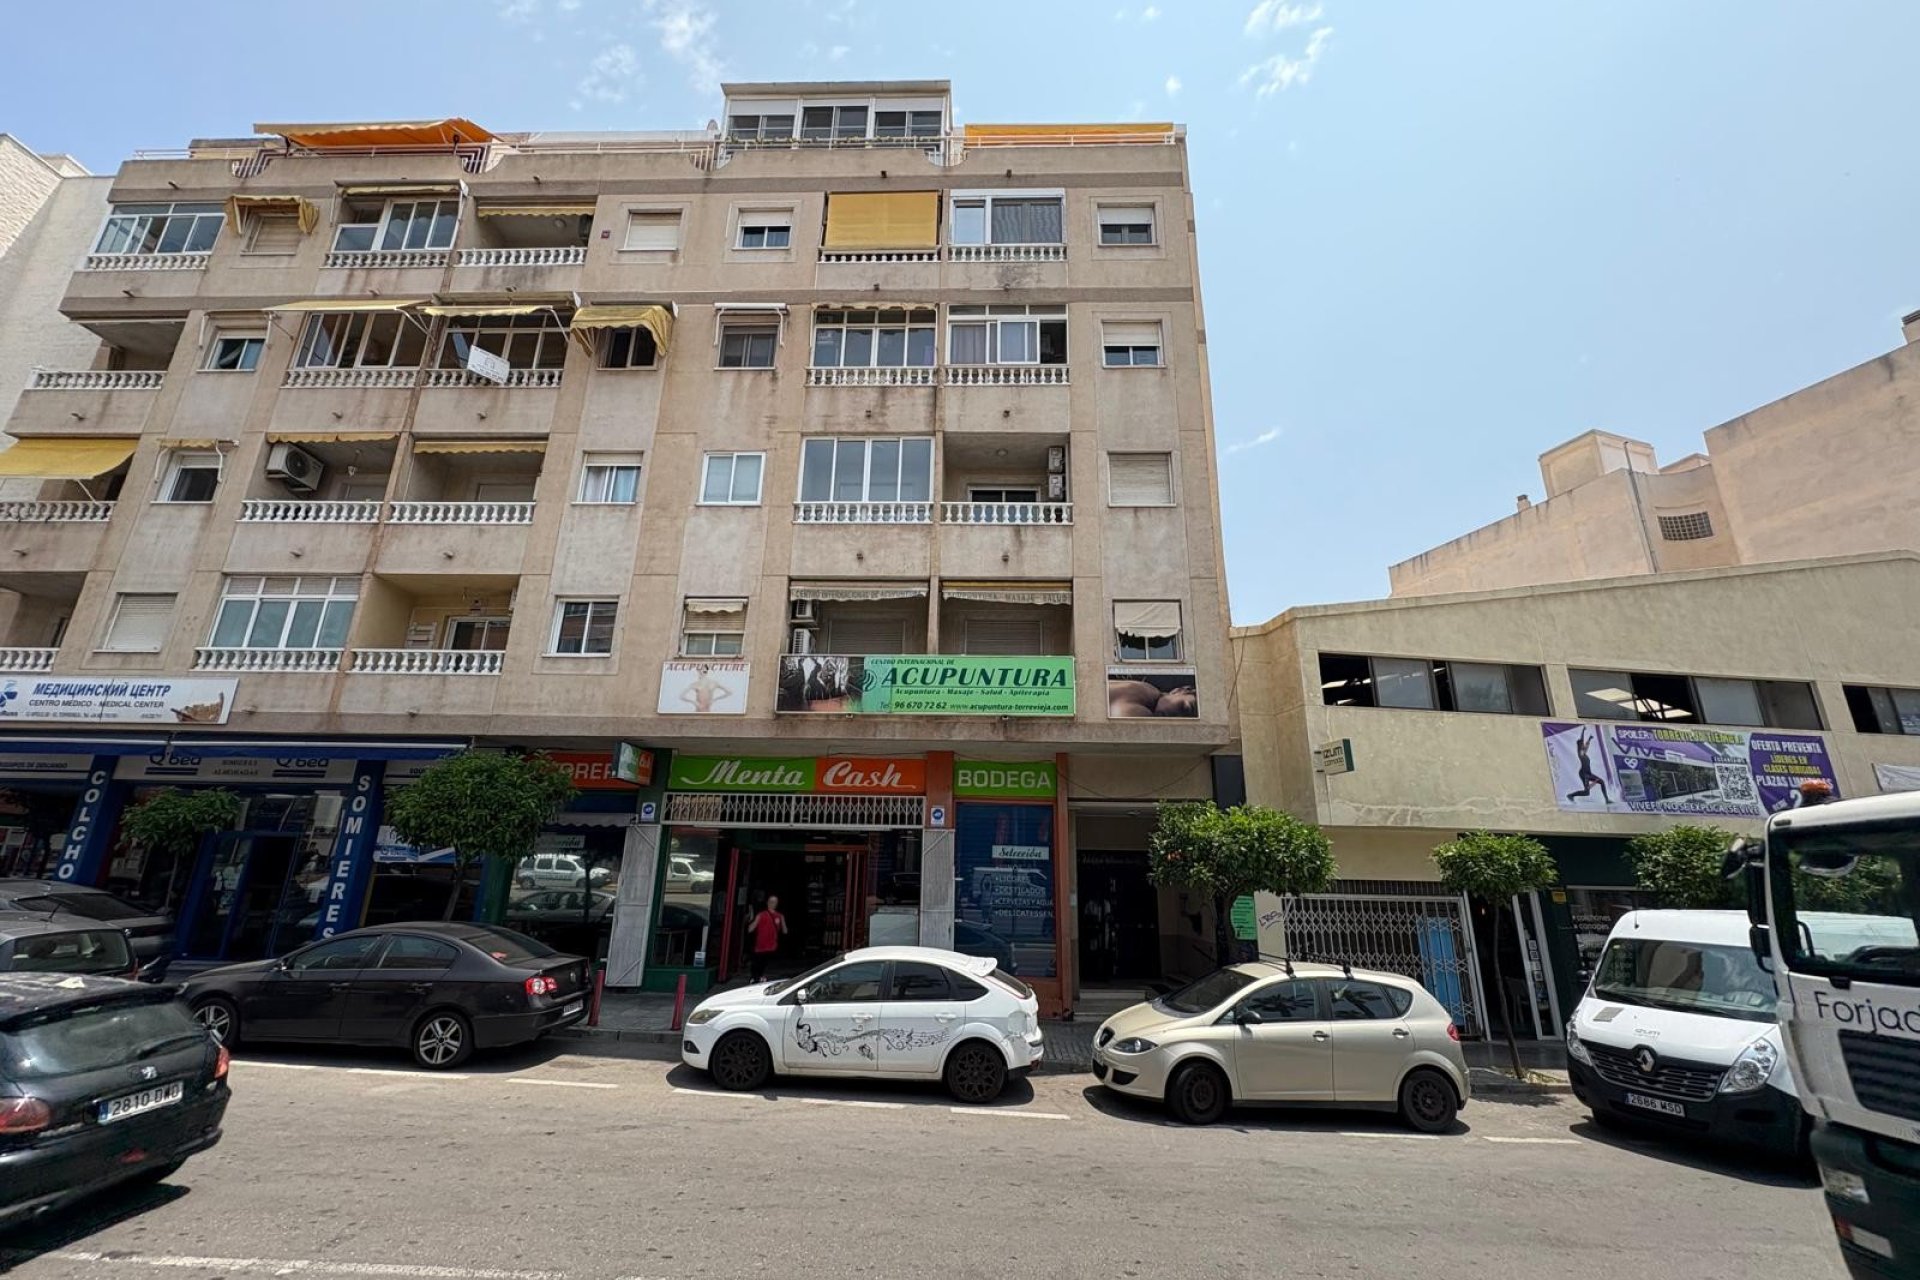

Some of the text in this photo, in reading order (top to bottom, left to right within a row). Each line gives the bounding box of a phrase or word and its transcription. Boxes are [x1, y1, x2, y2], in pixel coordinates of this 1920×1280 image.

[666, 663, 745, 671] ACUPUNCTURE
[881, 667, 1066, 686] ACUPUNTURA
[33, 682, 171, 698] МЕДИЦИНСКИЙ ЦЕНТР
[895, 688, 940, 696] Acupuntura
[98, 700, 132, 708] MEDICAL
[134, 700, 164, 708] CENTER
[895, 701, 905, 709] 96
[906, 701, 922, 709] 670
[1750, 740, 1823, 753] OFERTA PREVENTA
[680, 759, 806, 786] Menta
[822, 760, 917, 789] Cash
[958, 769, 1052, 788] BODEGA
[1756, 775, 1788, 787] PLAZAS
[112, 1092, 151, 1115] 2810
